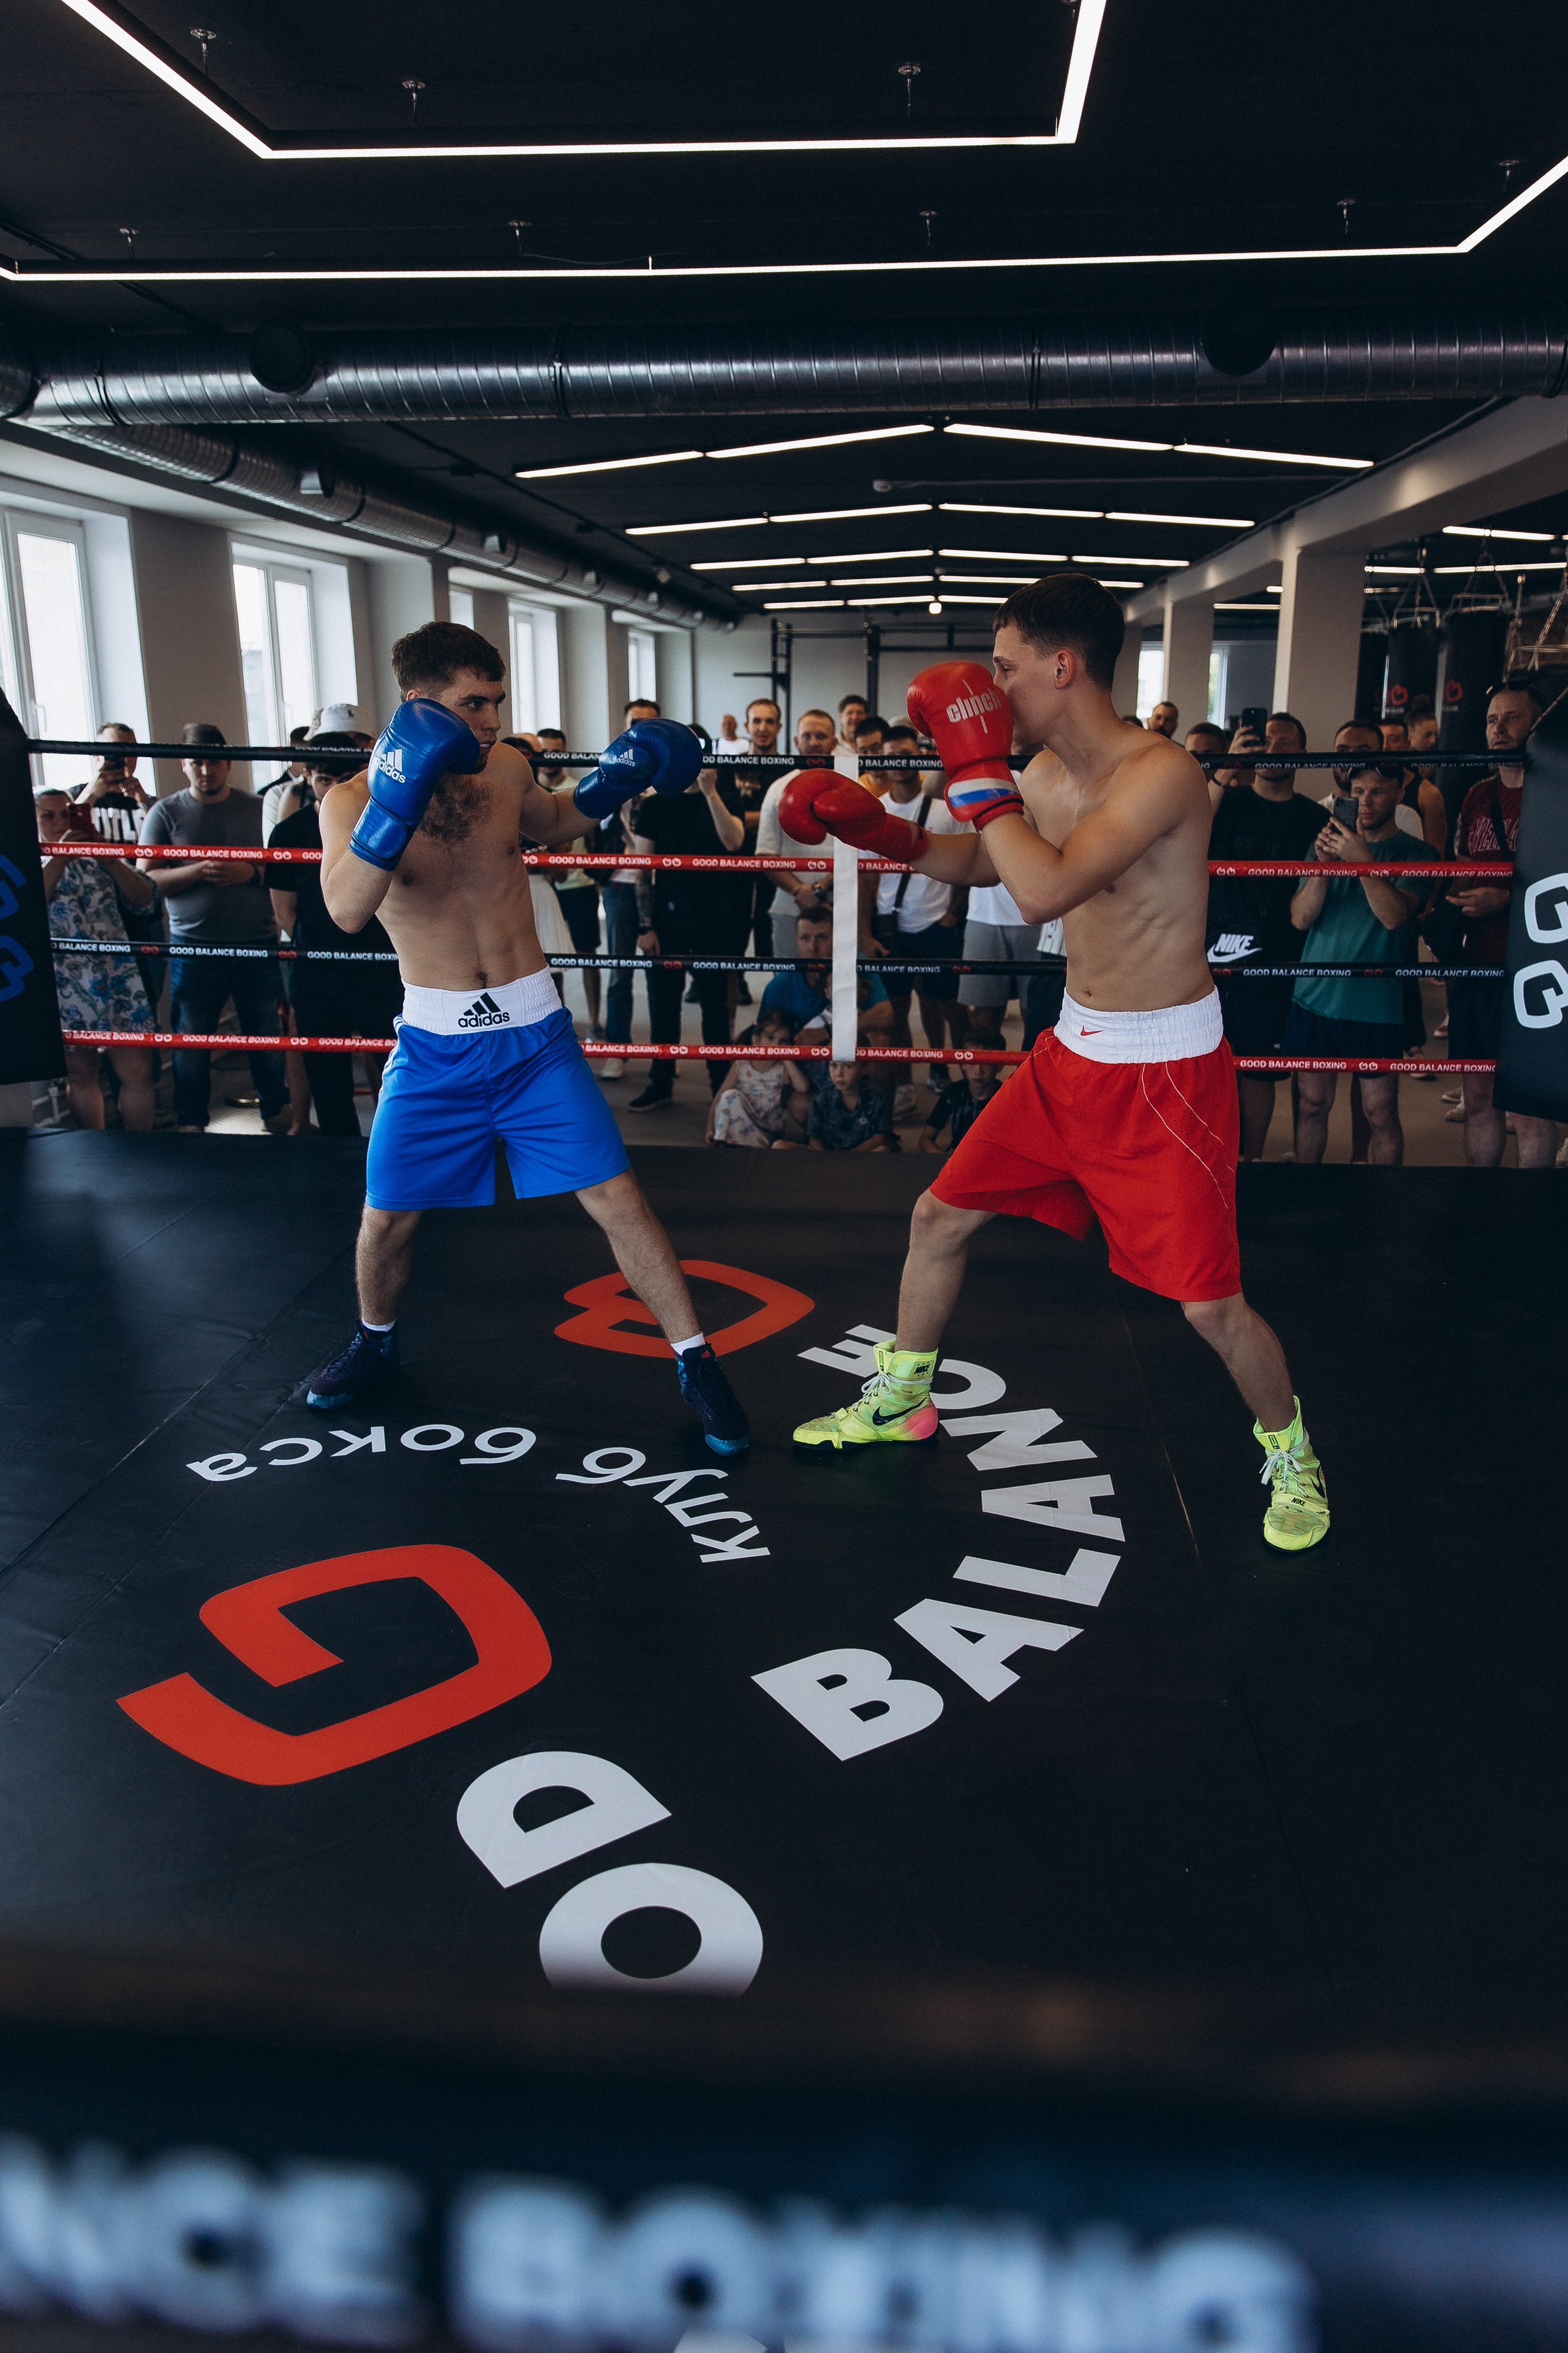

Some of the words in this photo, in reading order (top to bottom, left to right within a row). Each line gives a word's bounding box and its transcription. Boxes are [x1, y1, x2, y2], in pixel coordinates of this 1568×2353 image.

[946, 687, 1002, 723] clinch
[617, 757, 635, 767] adidas
[717, 756, 758, 765] BALANCE
[761, 757, 795, 766] BOXING
[910, 760, 943, 768] BOXING
[375, 757, 406, 784] adidas
[52, 847, 91, 856] BALANCE
[92, 848, 125, 856] BOXING
[163, 848, 189, 857] GOOD
[190, 849, 230, 859] BALANCE
[231, 850, 263, 859] BOXING
[302, 852, 322, 861] GOO
[548, 855, 575, 864] GOOD
[576, 856, 617, 865] BALANCE
[619, 857, 652, 866] BOXING
[692, 858, 718, 867] GOOD
[720, 858, 761, 868] BALANCE
[763, 859, 796, 869] BOXING
[59, 942, 98, 951] BALANCE
[99, 944, 131, 953] BOXING
[1214, 933, 1254, 953] NIKE
[169, 946, 194, 956] GOOD
[195, 947, 235, 956] BALANCE
[236, 948, 268, 957] BOXING
[307, 951, 332, 959] GOOD
[334, 951, 374, 961] BALANCE
[551, 957, 577, 966] GOOD
[578, 958, 618, 967] BALANCE
[620, 959, 653, 968] BOXING
[693, 961, 718, 970] GOOD
[720, 962, 761, 970] BALANCE
[865, 965, 905, 973] BALANCE
[458, 1012, 510, 1027] adidas
[74, 1031, 111, 1040] BALANCE
[113, 1032, 145, 1041] BOXING
[182, 1034, 208, 1043] GOOD
[208, 1035, 247, 1044] BALANCE
[248, 1036, 281, 1044] BOXING
[344, 1038, 384, 1047] BALANCE
[586, 1044, 626, 1053] BALANCE
[627, 1045, 660, 1054] BOXING
[698, 1046, 725, 1055] GOOD
[726, 1046, 766, 1056] BALANCE
[767, 1048, 801, 1057] BOXING
[868, 1048, 909, 1057] BALANCE
[910, 1049, 944, 1059] BOXING
[1240, 1059, 1267, 1068] GOOD
[1268, 1060, 1311, 1069] BALANCE
[1313, 1061, 1347, 1070] BOXING
[1390, 1062, 1417, 1071] GOOD
[1419, 1063, 1462, 1071] BALANCE
[914, 1364, 931, 1375] NIKE
[186, 1424, 537, 1482] бокса
[556, 1447, 771, 1563] клуб
[1291, 1497, 1306, 1506] NIKE
[456, 1751, 764, 1998] OD
[751, 1324, 1126, 1761] BALANCE
